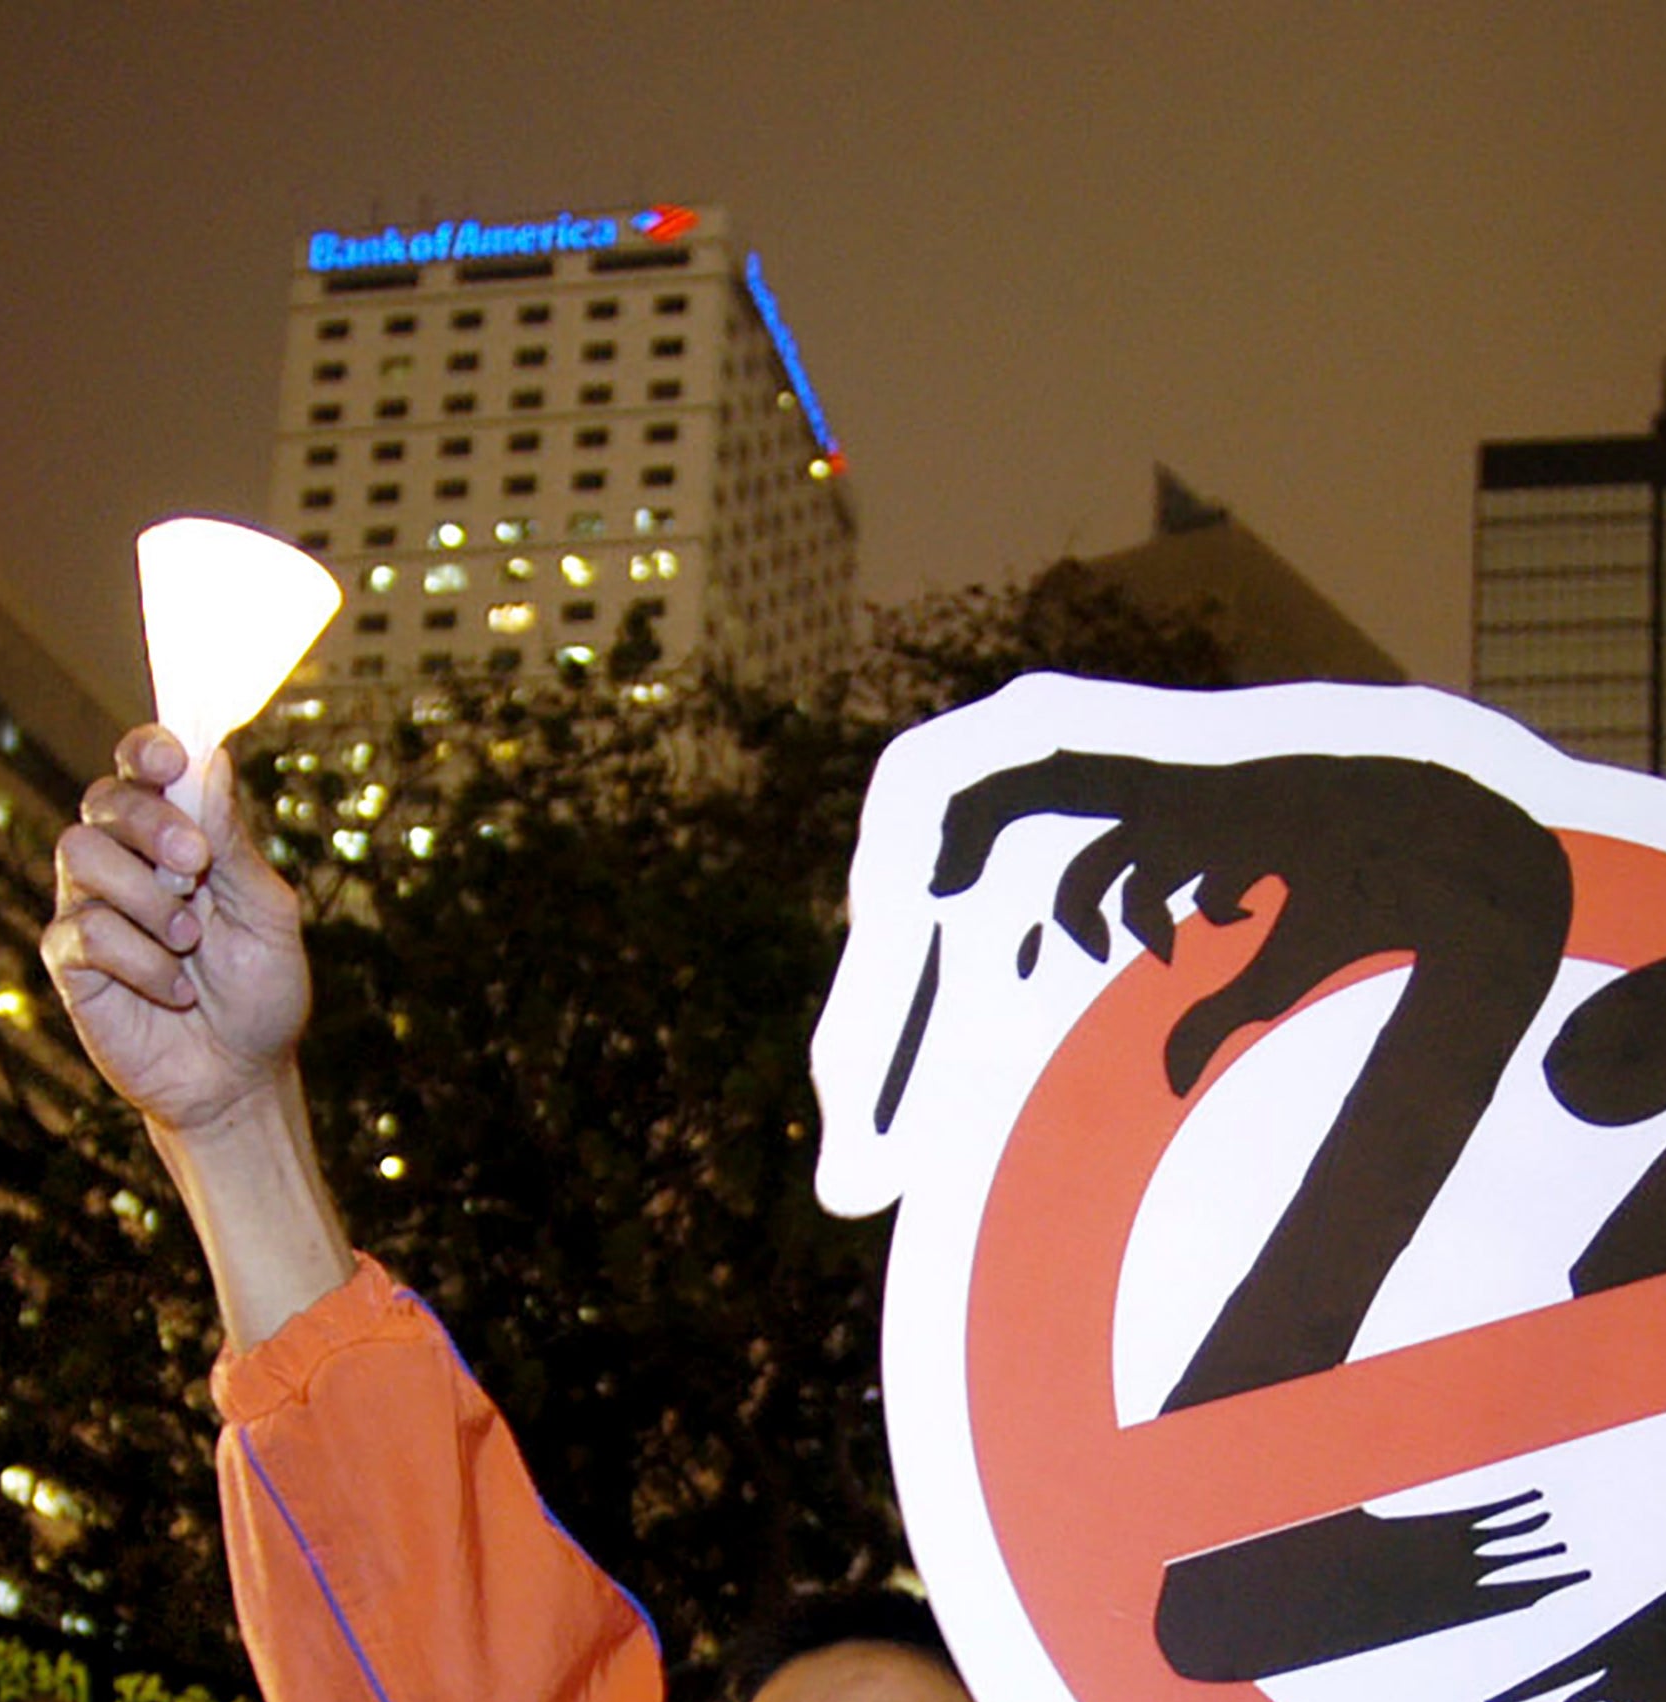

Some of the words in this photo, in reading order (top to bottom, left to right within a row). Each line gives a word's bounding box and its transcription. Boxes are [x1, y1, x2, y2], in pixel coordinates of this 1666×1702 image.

[309, 226, 408, 271] Bank
[409, 219, 456, 262] of
[453, 212, 617, 259] America
